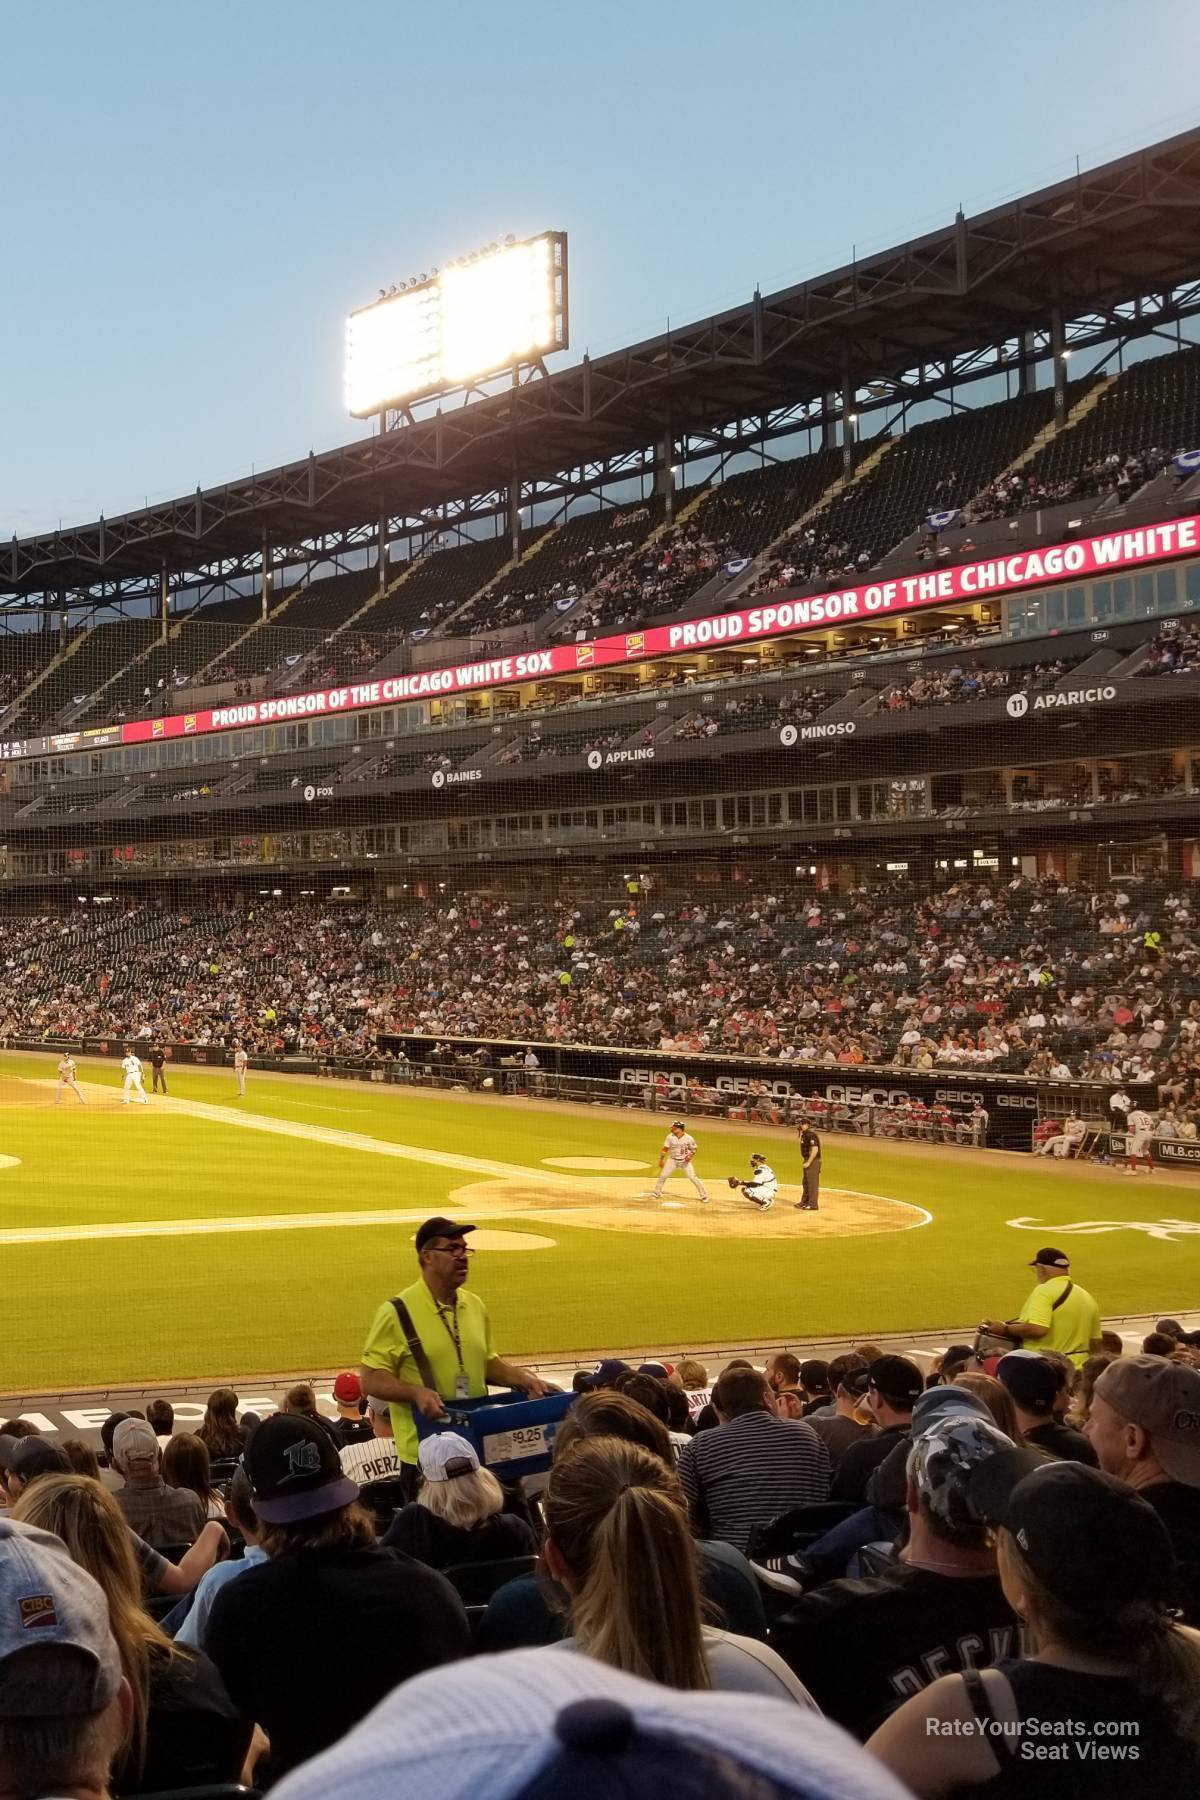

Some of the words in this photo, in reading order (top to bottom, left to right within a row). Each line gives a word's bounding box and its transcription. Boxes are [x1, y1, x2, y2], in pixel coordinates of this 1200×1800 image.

[669, 615, 742, 648] PROUD
[748, 592, 858, 633] SPONSOR
[864, 583, 897, 610] OF
[902, 572, 953, 602] THE
[960, 544, 1084, 592] CHICAGO
[1092, 520, 1197, 565] WHITE
[212, 707, 257, 727] PROUD
[260, 693, 326, 719] SPONSOR
[329, 690, 349, 708] OF
[350, 684, 380, 704] THE
[383, 670, 453, 699] CHICAGO
[455, 659, 512, 687] WHITE
[516, 652, 552, 675] SOX
[1033, 686, 1116, 709] APARICIO
[801, 720, 856, 740] MINOSO
[606, 748, 655, 764] APPLING
[446, 770, 482, 783] BAINES
[317, 787, 334, 796] FOX
[935, 1089, 984, 1104] GEICO
[513, 1427, 542, 1444] $9.25
[362, 1455, 400, 1480] PIERZ
[21, 1597, 53, 1612] CIBC
